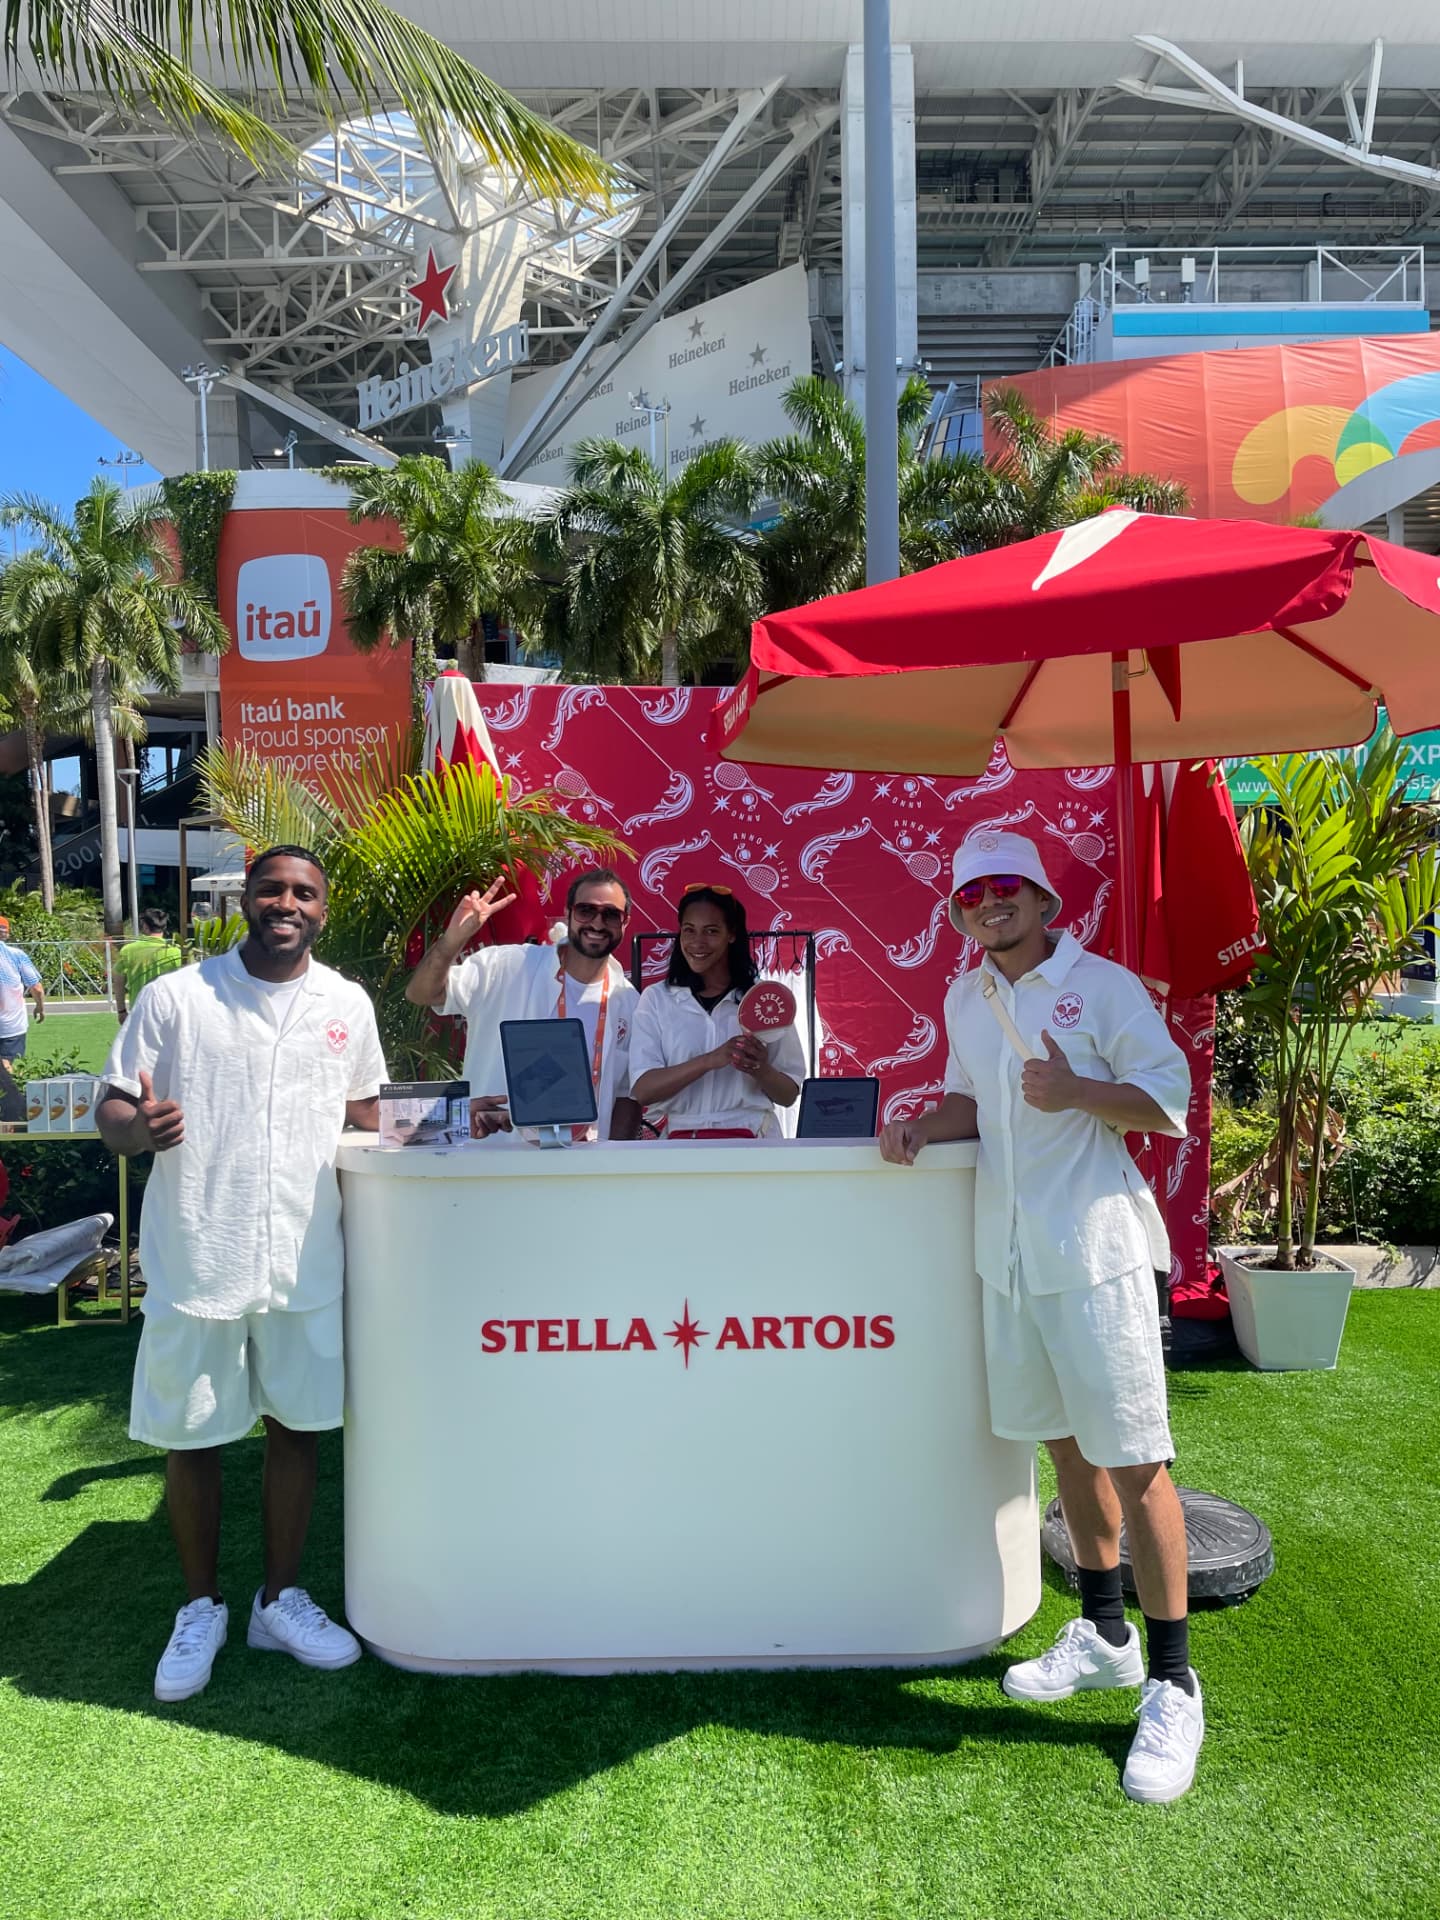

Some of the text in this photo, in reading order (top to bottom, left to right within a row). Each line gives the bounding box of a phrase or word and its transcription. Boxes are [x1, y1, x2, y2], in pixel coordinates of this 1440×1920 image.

[668, 337, 726, 369] Heineken
[356, 320, 529, 431] Heineken
[728, 365, 791, 396] Heineken
[246, 600, 321, 641] itaú
[240, 695, 346, 724] Itaú bank
[242, 723, 389, 750] Proud sponsor
[274, 753, 327, 771] more
[733, 832, 762, 845] ANNO
[894, 819, 924, 831] ANNO
[55, 846, 94, 877] 200
[754, 1002, 780, 1024] ARTOIS
[760, 993, 785, 1014] STELLA
[481, 1315, 895, 1353] STELLA ARTOIS
